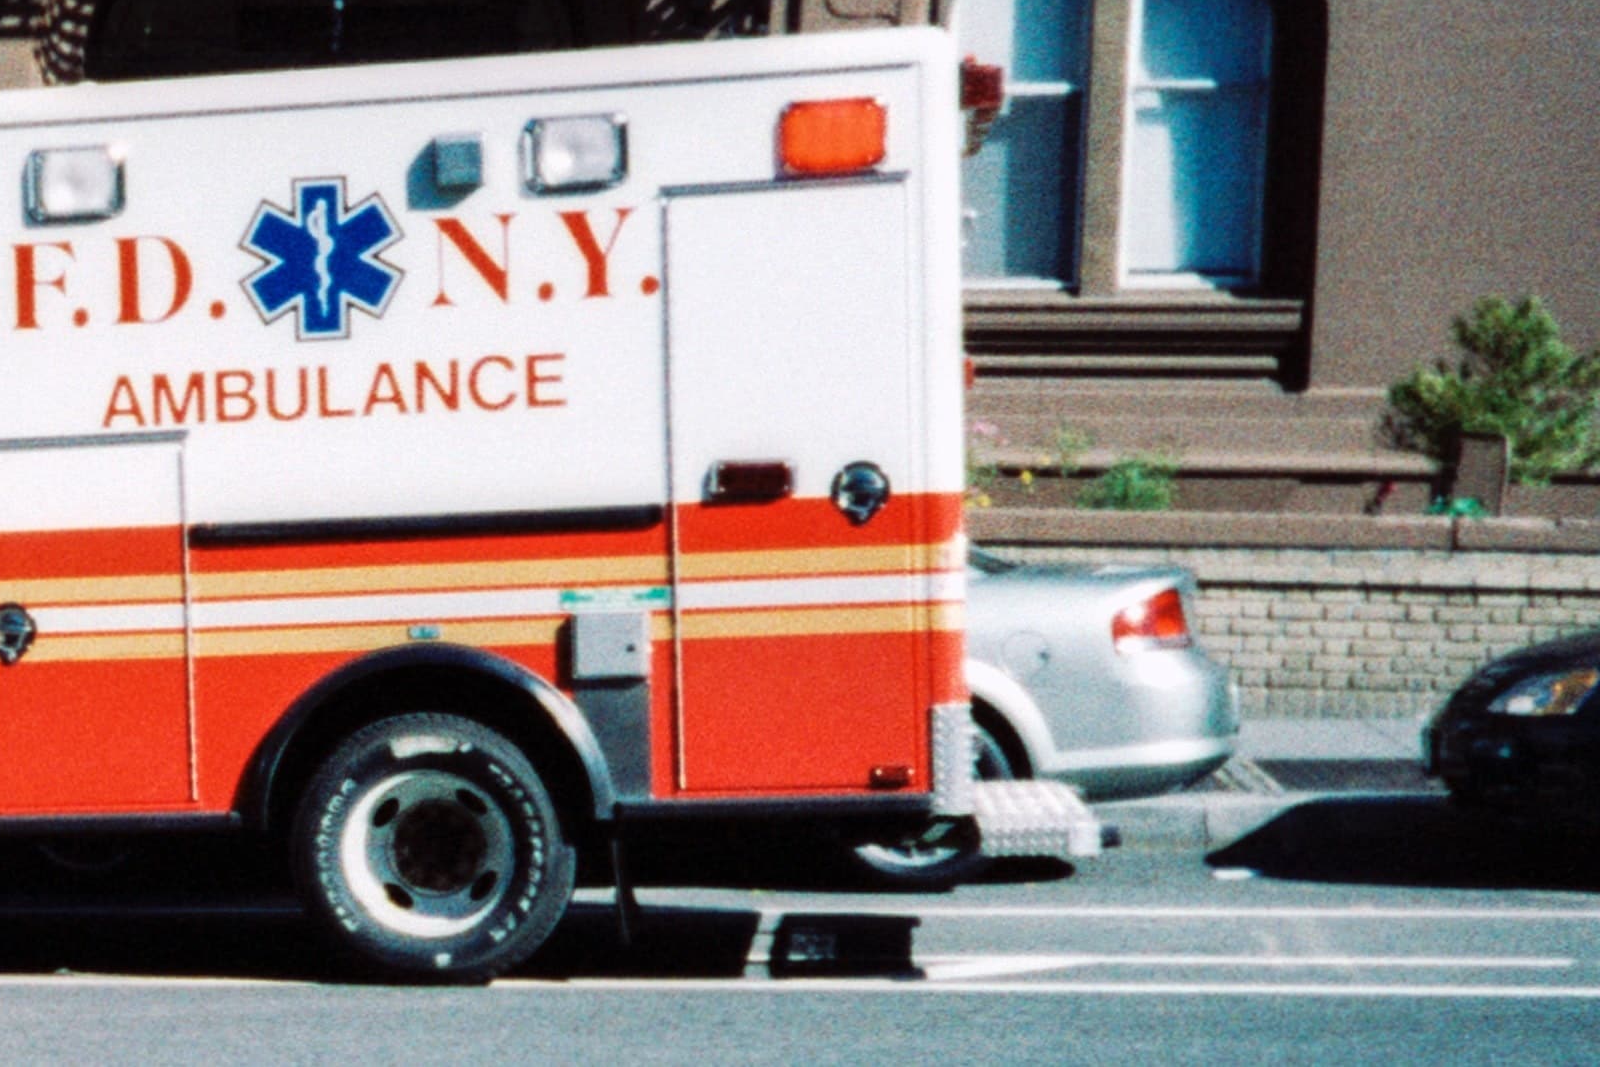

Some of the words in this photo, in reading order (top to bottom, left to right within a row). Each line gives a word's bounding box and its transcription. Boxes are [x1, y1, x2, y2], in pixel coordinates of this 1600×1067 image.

[12, 237, 227, 331] F.D.
[432, 206, 661, 308] N.Y.
[102, 352, 566, 430] AMBULANCE
